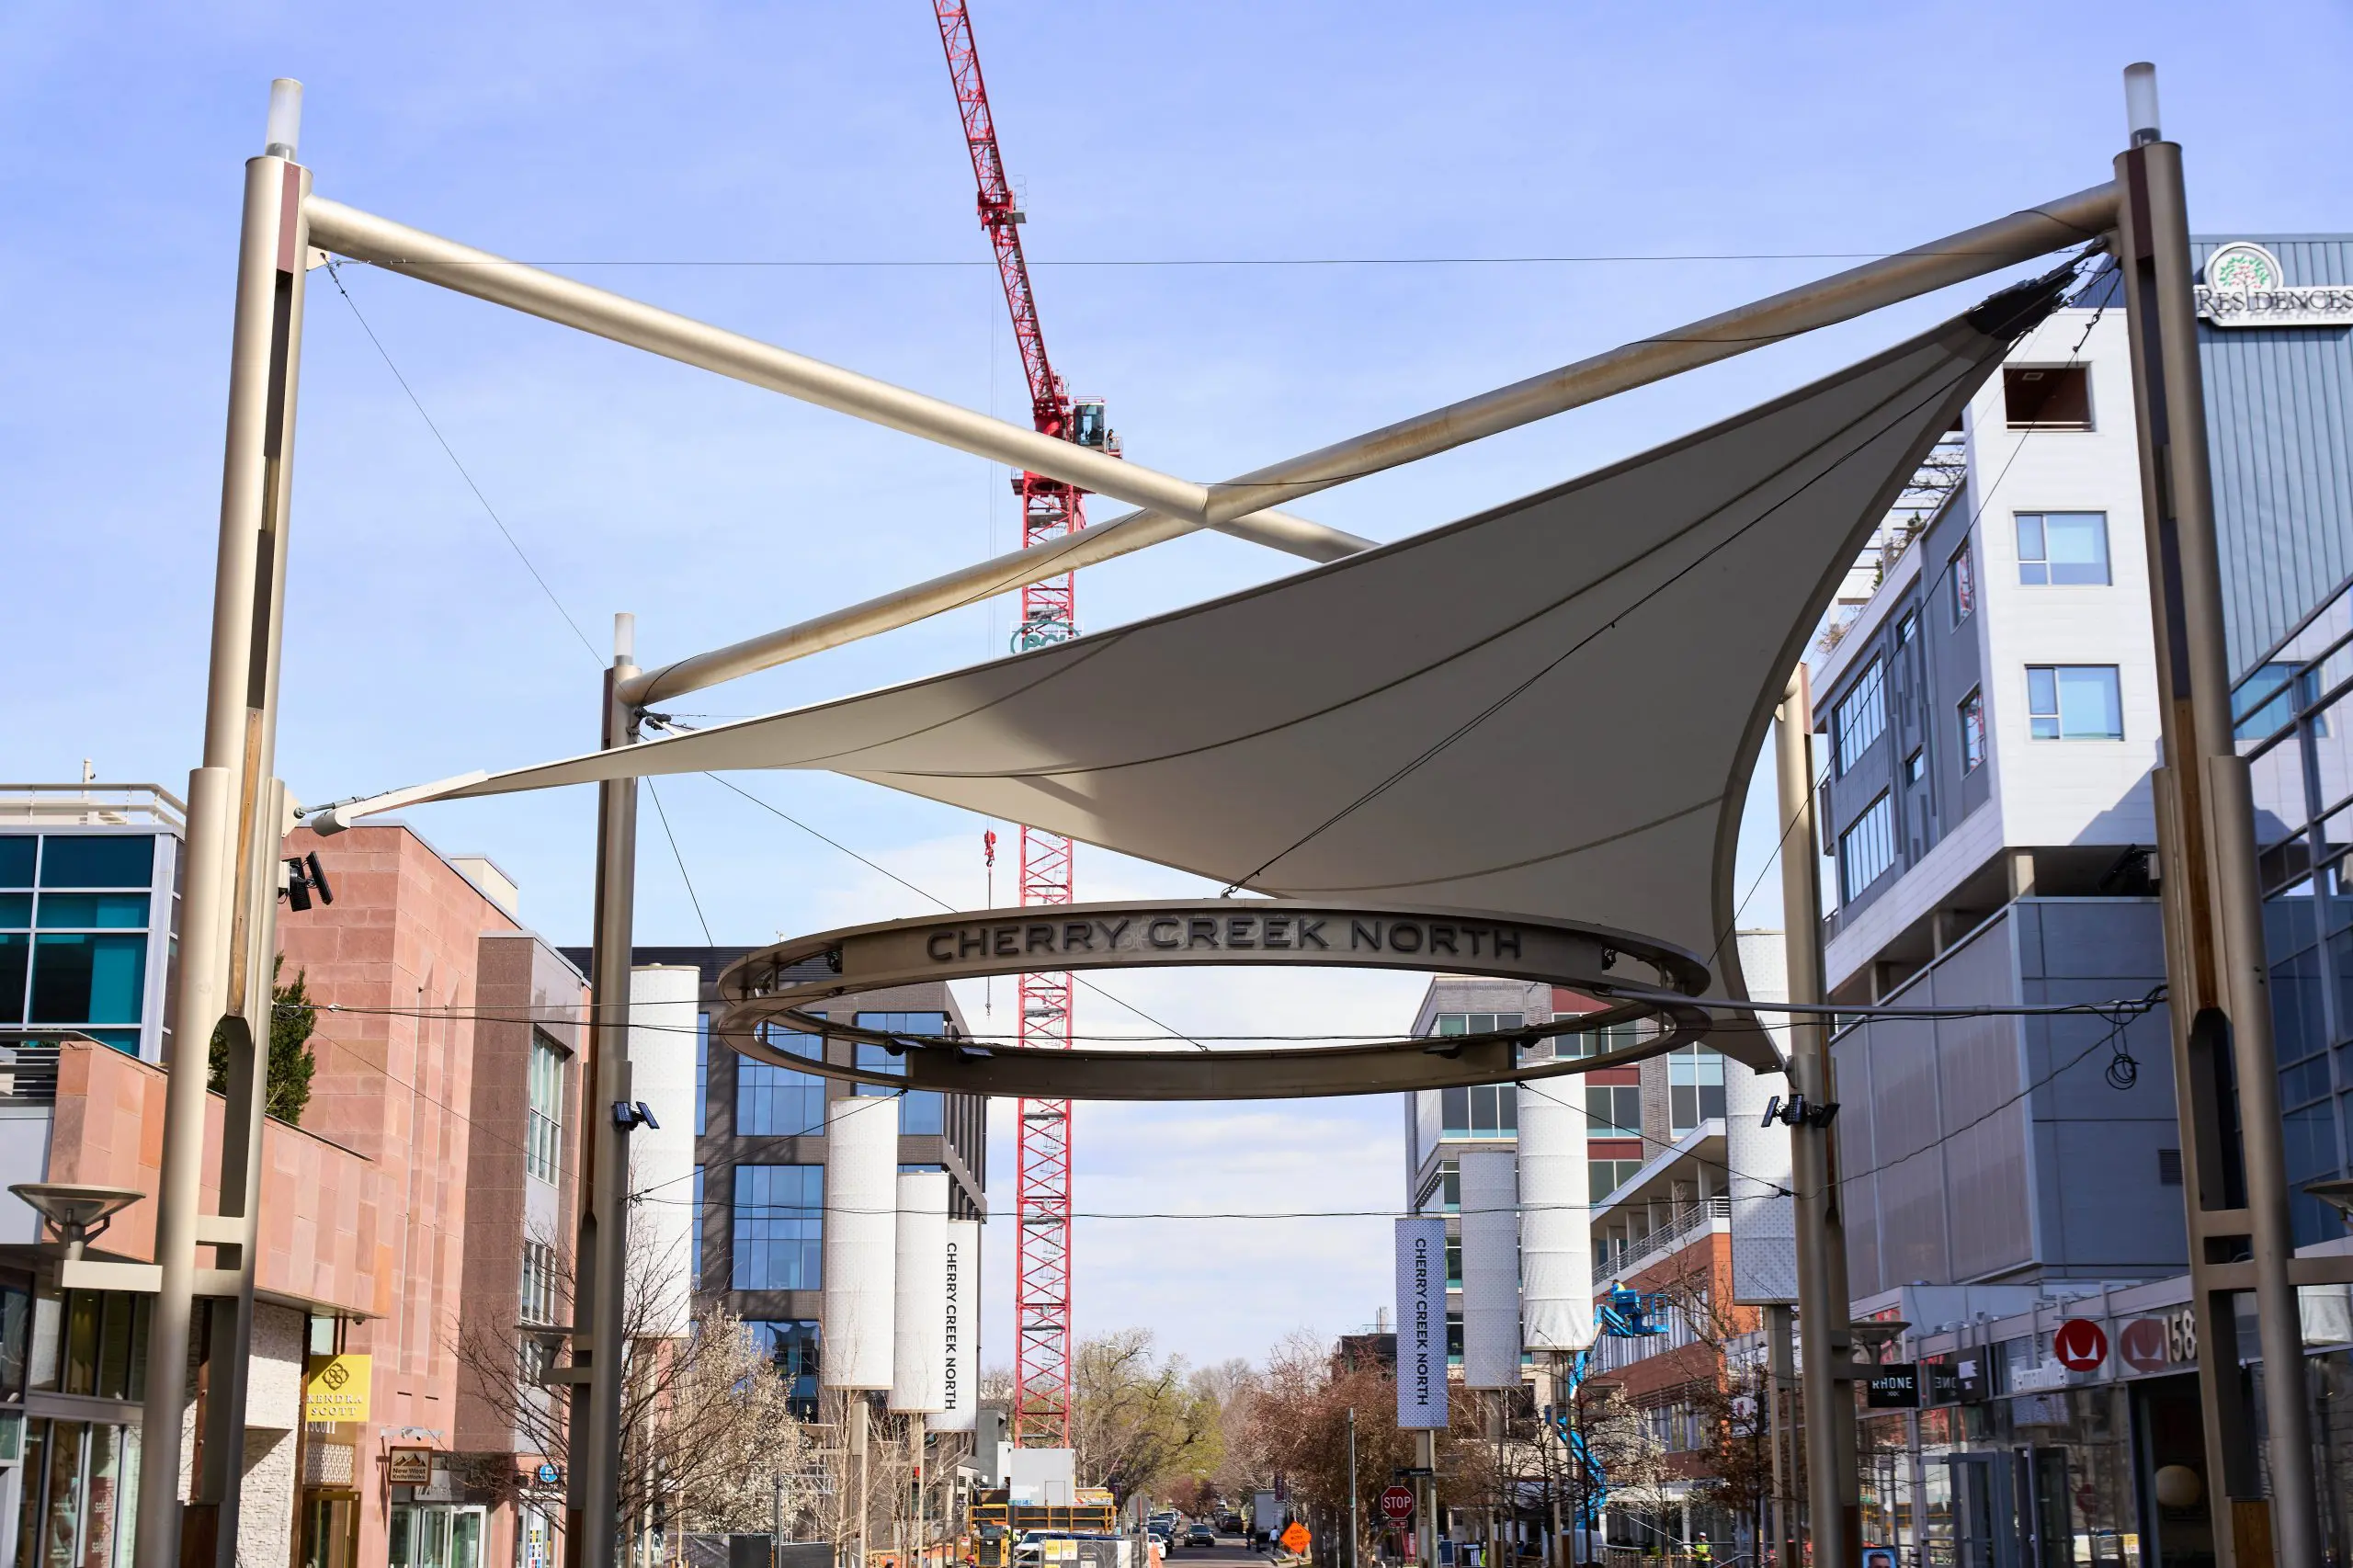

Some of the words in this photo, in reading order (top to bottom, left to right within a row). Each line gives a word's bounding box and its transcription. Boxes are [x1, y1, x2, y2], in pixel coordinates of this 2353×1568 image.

[926, 920, 1130, 961] CHERRY
[1149, 918, 1329, 948] CREEK
[1351, 920, 1521, 959] NORTH
[946, 1242, 957, 1302] CHERRY
[1415, 1237, 1427, 1299] CHERRY
[946, 1305, 957, 1353] CREEK
[1415, 1300, 1428, 1349] CREEK
[307, 1394, 363, 1404] KENDRA
[945, 1358, 957, 1410] NORTH
[1416, 1354, 1428, 1405] NORTH
[1871, 1377, 1914, 1389] RHONE
[311, 1406, 357, 1416] SCOTT
[1383, 1496, 1411, 1509] STOP
